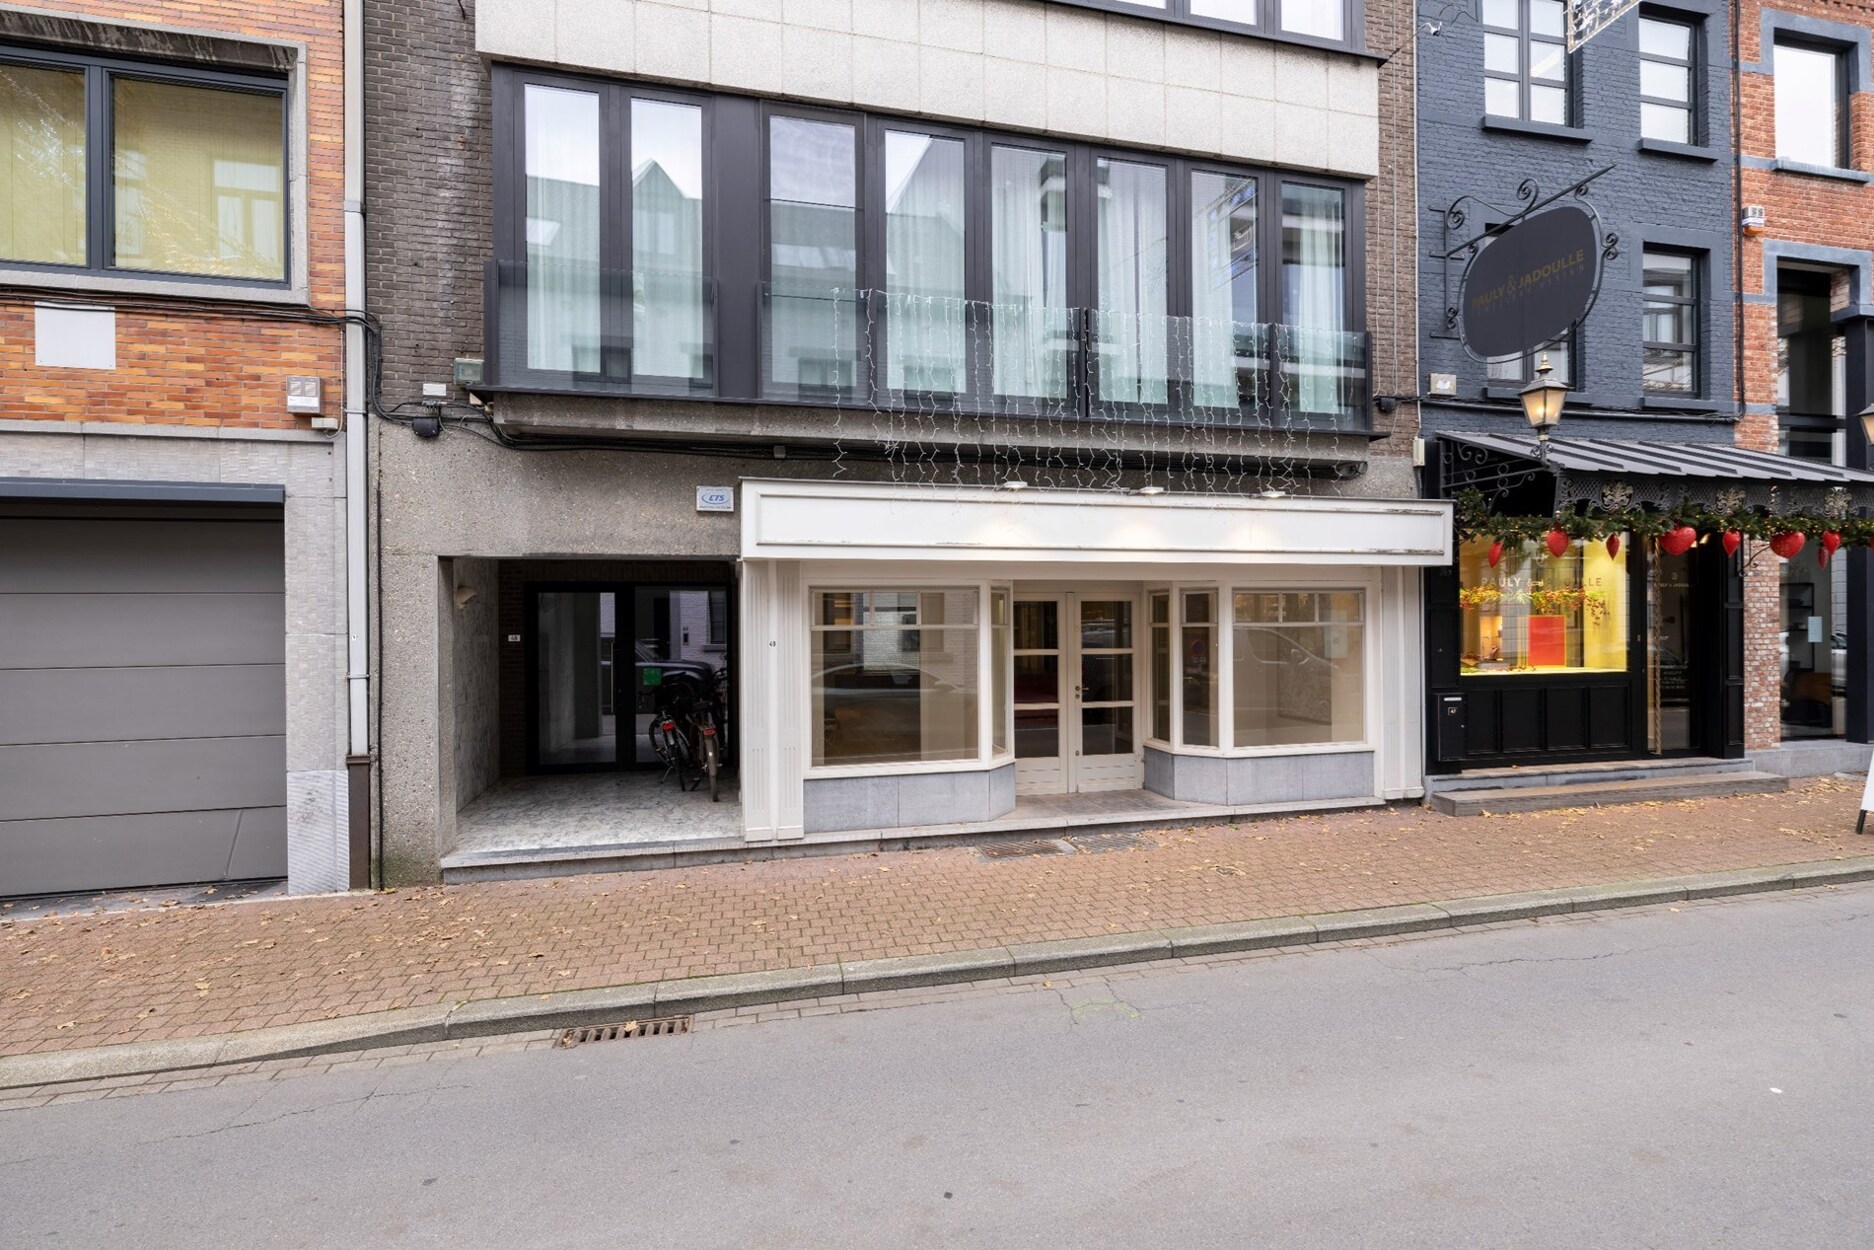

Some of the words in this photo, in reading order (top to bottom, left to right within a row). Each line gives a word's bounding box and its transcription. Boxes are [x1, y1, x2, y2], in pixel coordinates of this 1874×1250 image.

[1507, 274, 1516, 294] &
[1518, 249, 1584, 289] JADOULLE
[1481, 577, 1521, 587] PAULY
